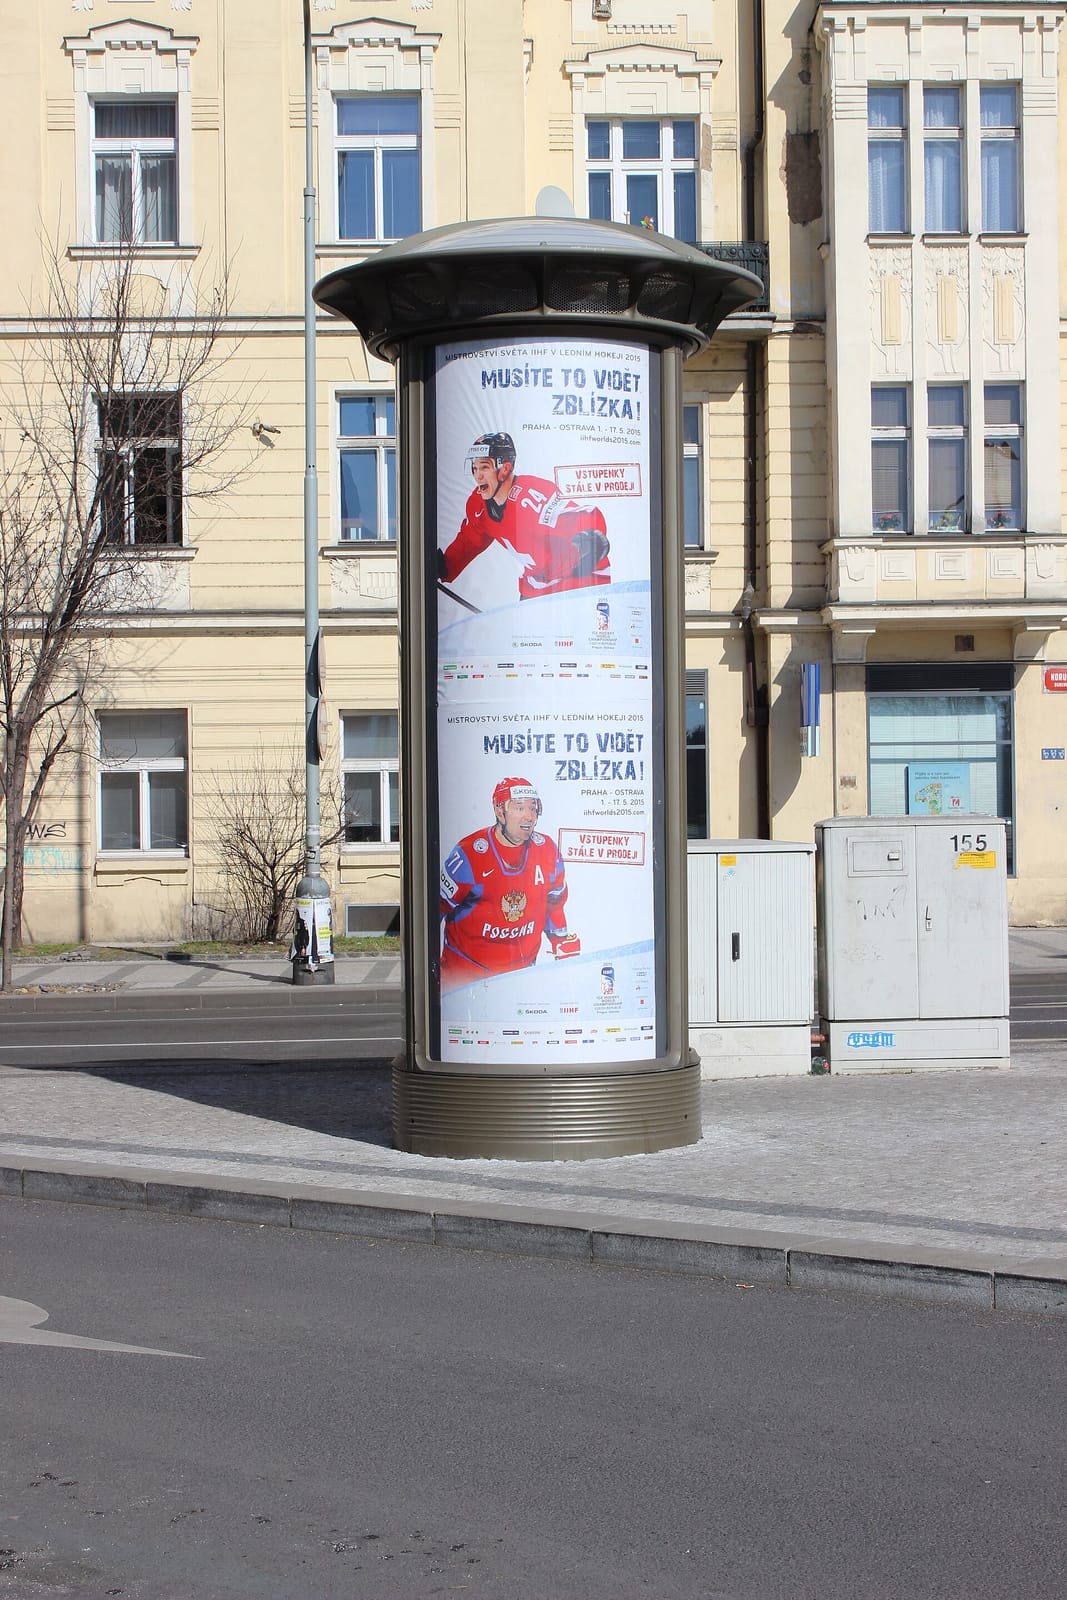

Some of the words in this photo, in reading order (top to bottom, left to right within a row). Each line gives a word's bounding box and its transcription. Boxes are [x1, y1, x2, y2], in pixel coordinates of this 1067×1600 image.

[445, 351, 498, 360] MISTROVSTVÍ
[500, 348, 528, 357] SVĚTA
[560, 348, 592, 357] LEDNÍM
[594, 351, 624, 360] HOKEJI
[625, 353, 641, 362] 2015
[481, 362, 553, 390] MUSÍTE
[561, 368, 586, 388] TO
[593, 367, 641, 393] VIDĚT
[551, 391, 641, 421] ZBLÍZKA!
[522, 423, 551, 431] PRAHA
[559, 423, 596, 432] OSTRAVA
[609, 426, 618, 434] 17.
[619, 427, 626, 435] 5.
[626, 428, 641, 436] 2015
[580, 434, 641, 446] iihfworlds2015.com
[575, 468, 625, 479] VSTUPENKY
[566, 481, 593, 493] STÁLE
[595, 482, 602, 492] V
[604, 481, 635, 492] PRODEJI
[521, 488, 548, 514] 24
[447, 713, 500, 723] MISTROVSTVÍ
[502, 713, 530, 722] SVĚTA
[562, 712, 594, 721] LEDNÍM
[628, 714, 644, 722] 2015
[483, 728, 556, 755] MUSÍTE
[563, 733, 589, 753] TO
[596, 728, 644, 753] VIDĚT
[554, 755, 644, 781] ZBLÍZKA!
[583, 808, 645, 816] iihfworlds2015.com
[579, 834, 630, 847] VSTUPENKY
[950, 834, 987, 852] 155
[567, 845, 595, 858] STÁLE
[598, 848, 604, 858] V
[606, 848, 638, 860] PRODEJI
[447, 851, 464, 875] 71
[534, 864, 545, 886] A
[482, 921, 535, 939] РОССИЯ
